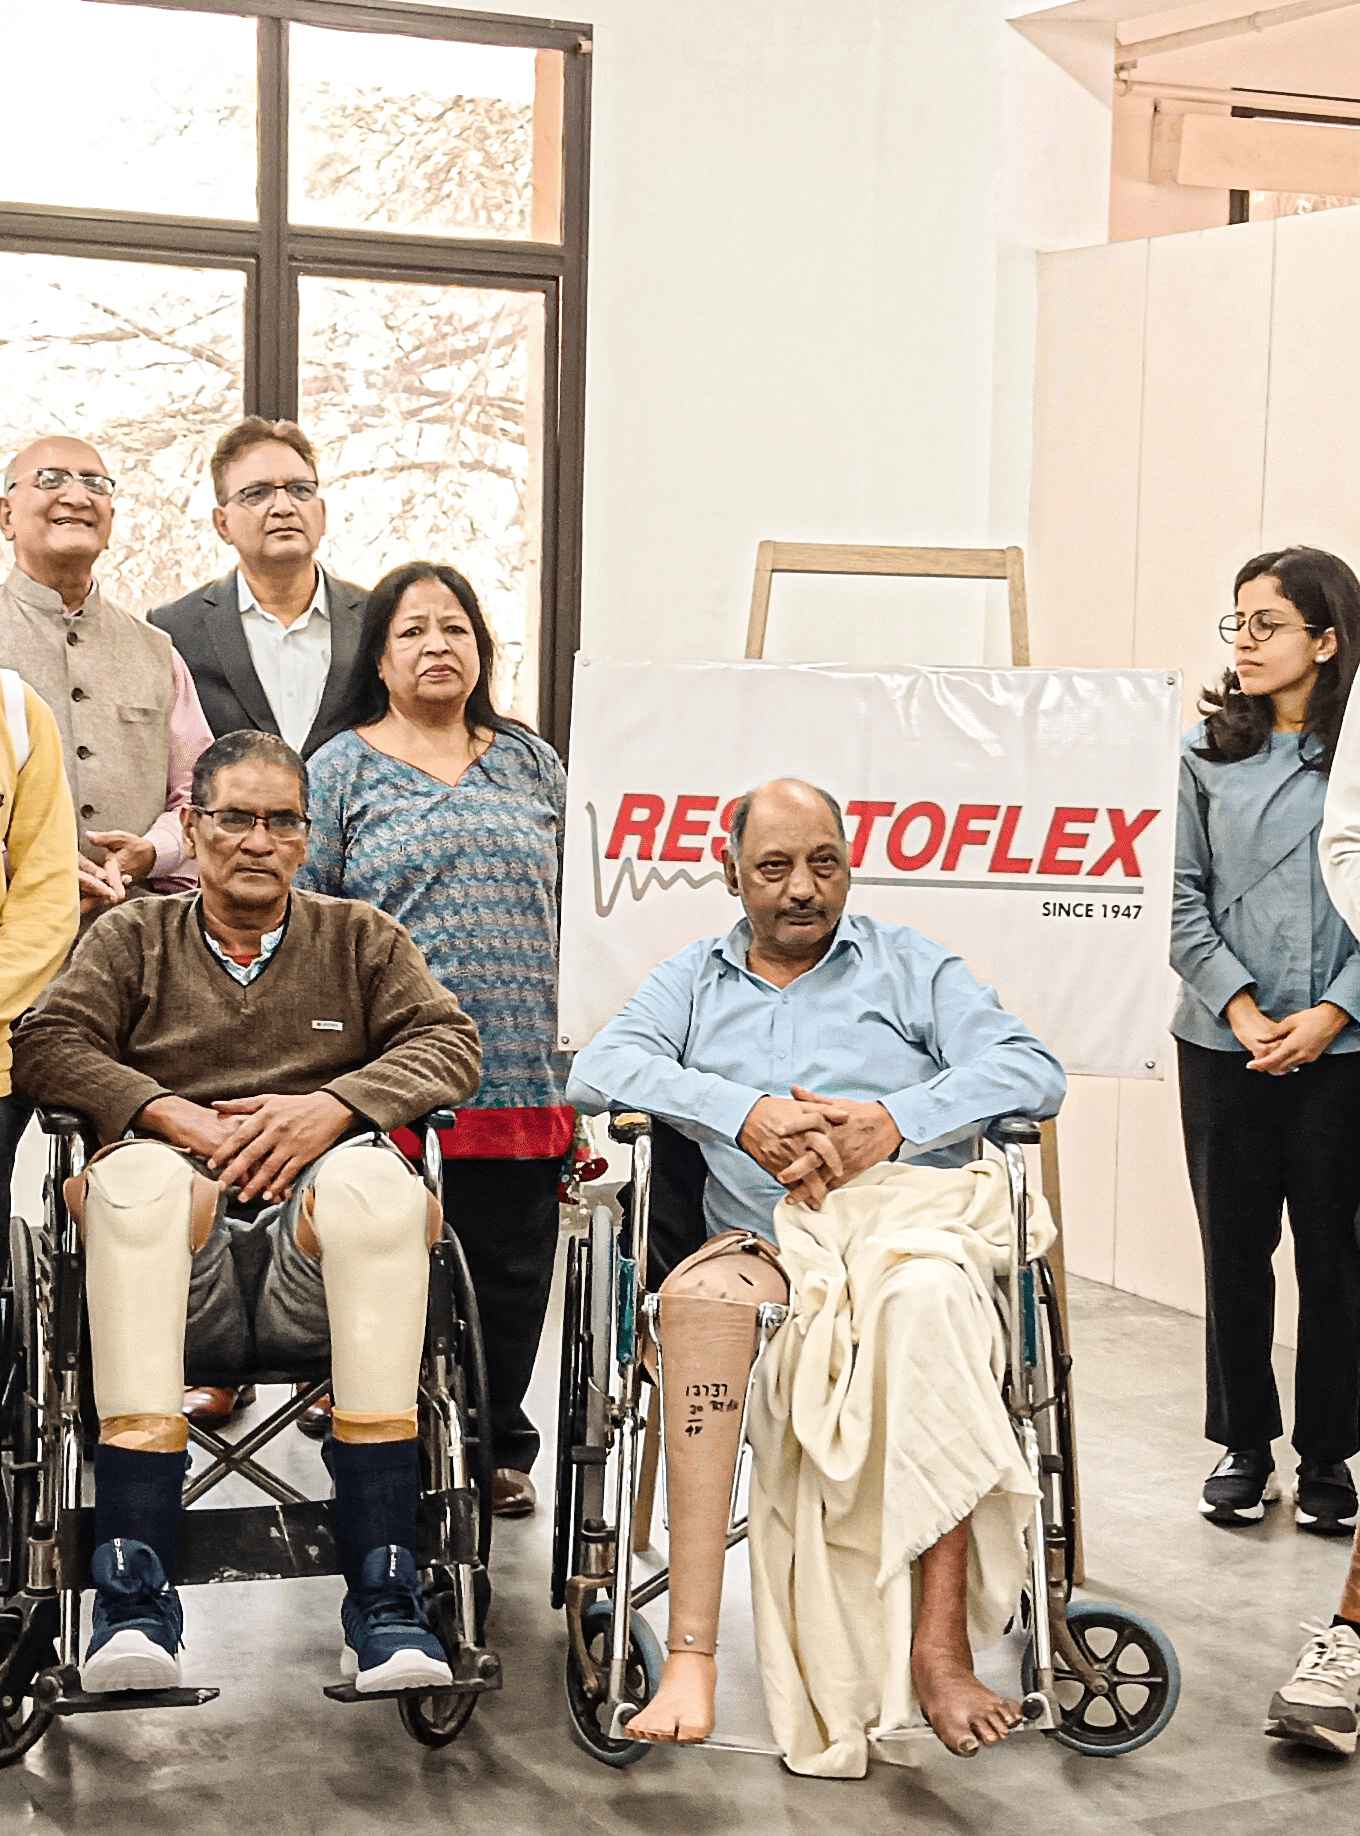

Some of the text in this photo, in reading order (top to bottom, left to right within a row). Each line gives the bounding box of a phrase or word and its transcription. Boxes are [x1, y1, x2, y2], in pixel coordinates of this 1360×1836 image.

[604, 792, 1161, 878] RETOFLEX
[1042, 901, 1143, 919] SINCE 1947
